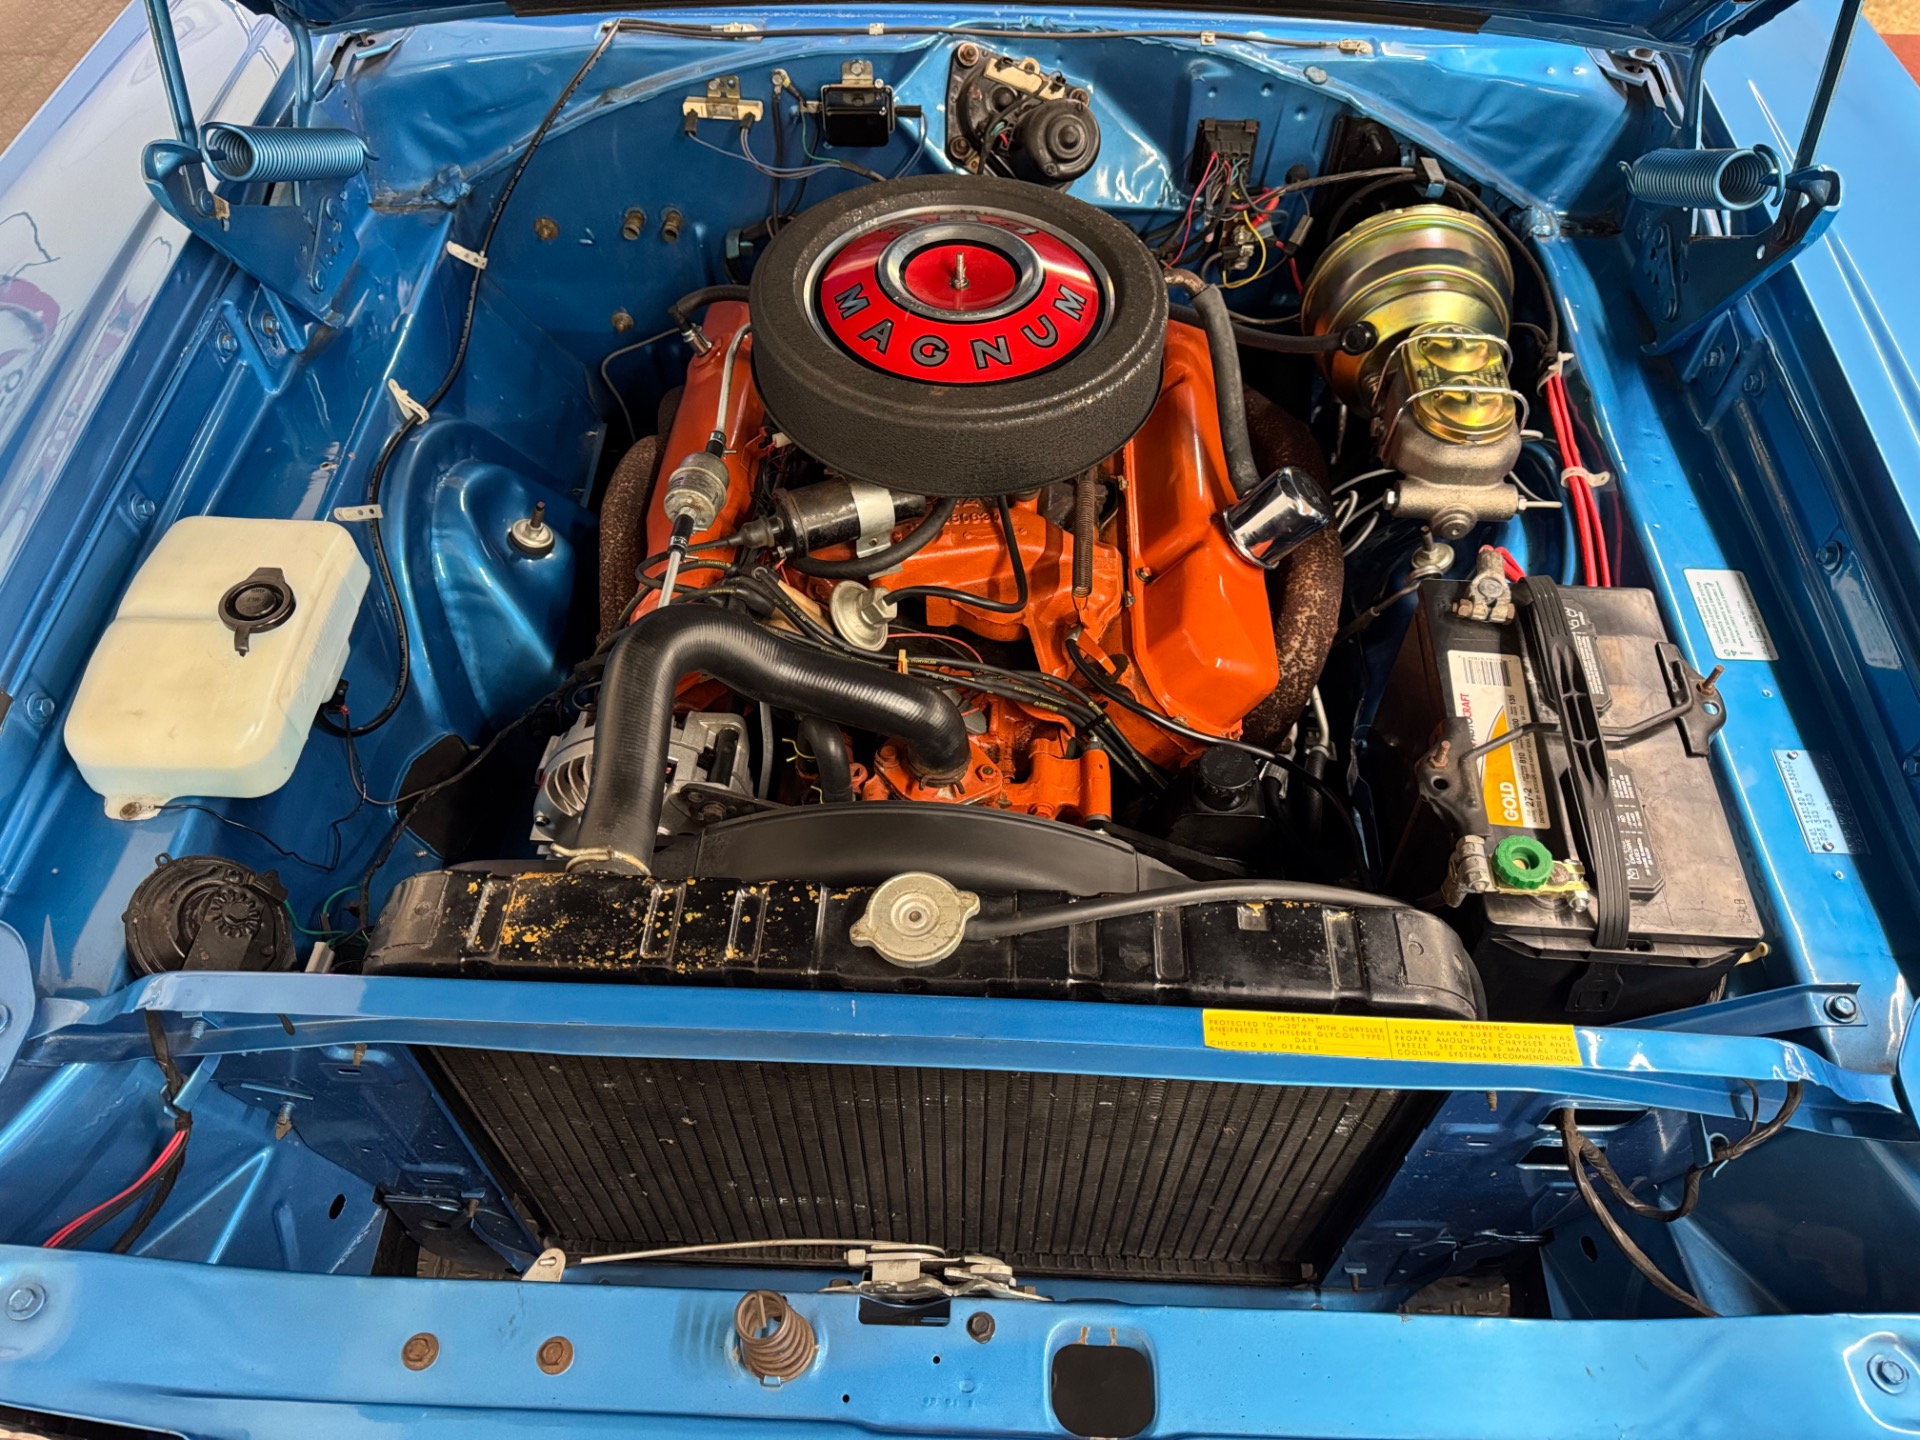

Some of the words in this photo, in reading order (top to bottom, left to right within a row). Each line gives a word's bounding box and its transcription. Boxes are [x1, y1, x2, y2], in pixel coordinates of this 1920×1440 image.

[834, 282, 1088, 369] MAGNUM
[1499, 781, 1519, 821] GOLD
[1523, 787, 1535, 808] 27-2
[1634, 848, 1642, 865] GASES
[1209, 1020, 1258, 1028] PROTECTED
[1342, 1026, 1384, 1034] CHRYSLER
[1210, 1040, 1256, 1048] CHECKED
[1498, 1032, 1546, 1040] COOLANT
